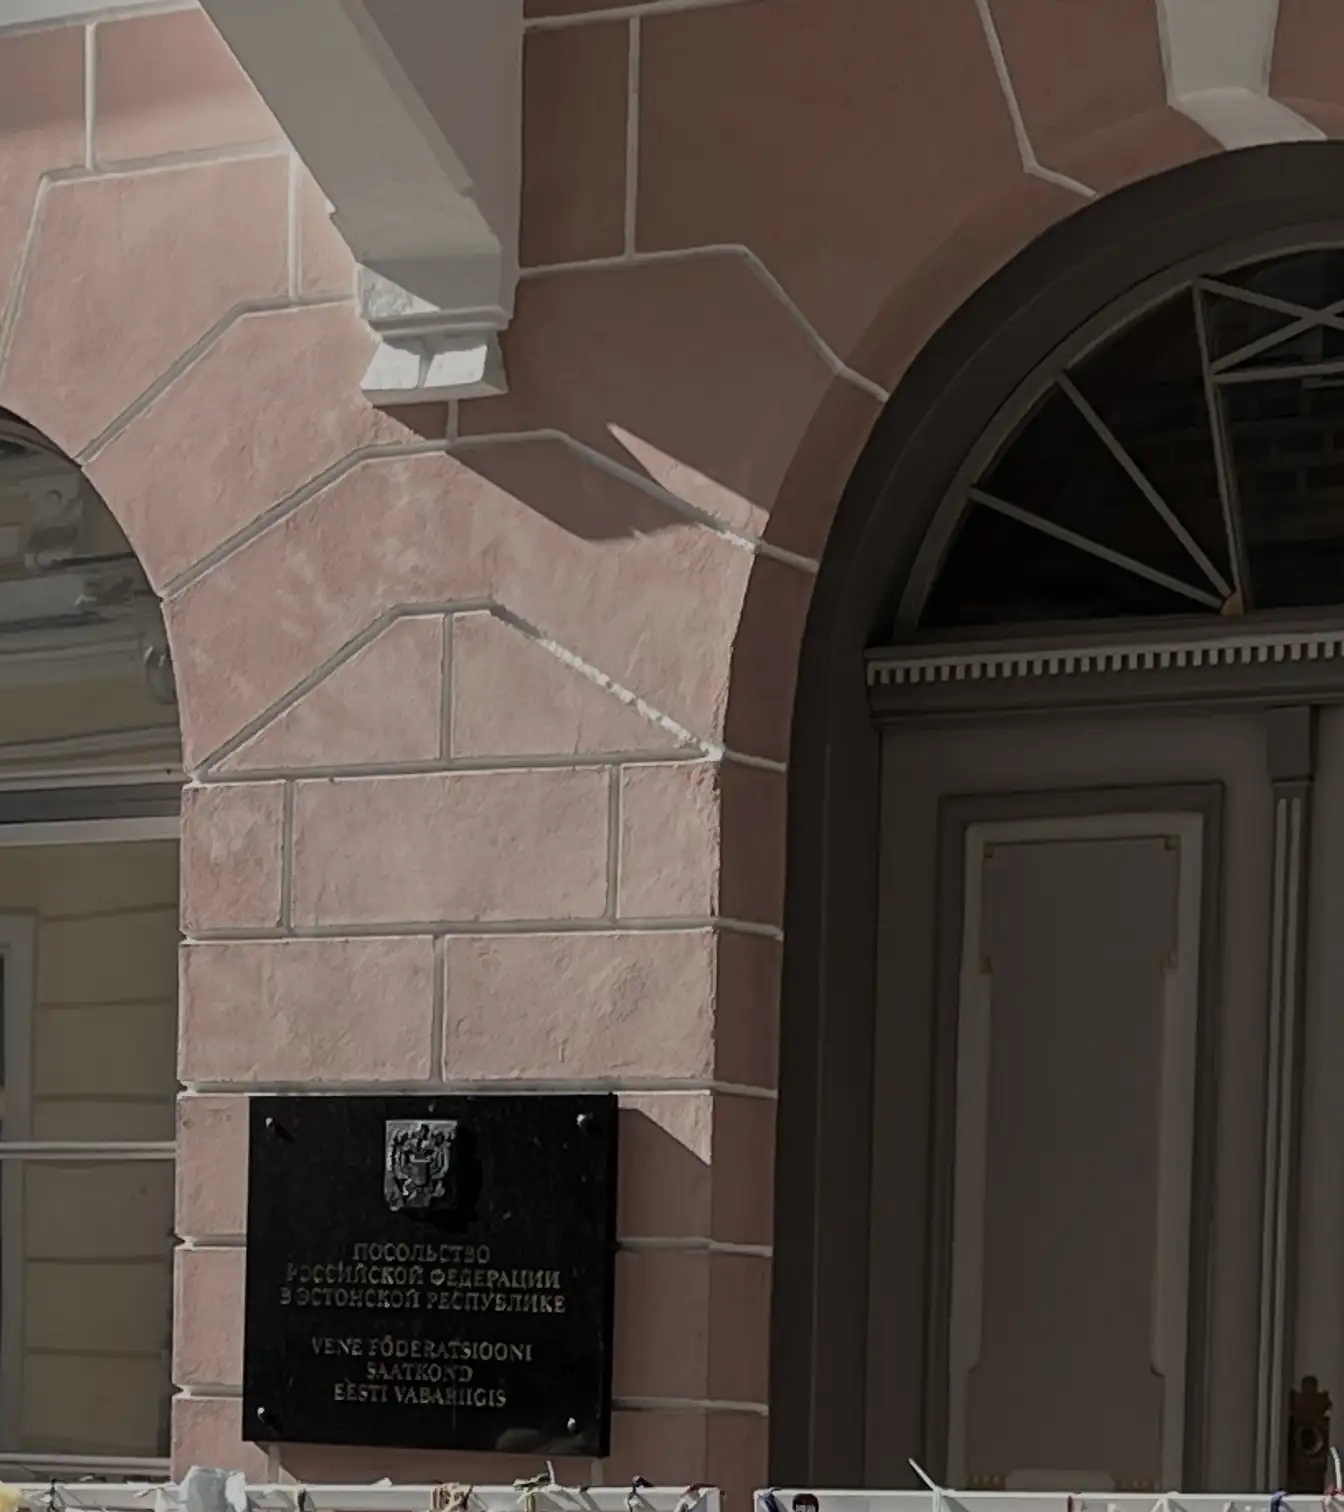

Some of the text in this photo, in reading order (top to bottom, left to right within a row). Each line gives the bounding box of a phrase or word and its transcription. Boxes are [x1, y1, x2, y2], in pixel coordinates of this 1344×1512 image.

[352, 1242, 491, 1264] ПОСОЛЬСТВО
[286, 1257, 562, 1291] РОССИЙСКОЙ ФЕДЕРАЦИИ
[296, 1287, 421, 1309] ЭСТОНСКОЙ
[427, 1290, 567, 1314] РЕСПУБЛИКЕ
[312, 1336, 363, 1356] VENE
[365, 1361, 474, 1383] SAATKOND
[333, 1383, 508, 1408] EESTI VABARIIGIS
